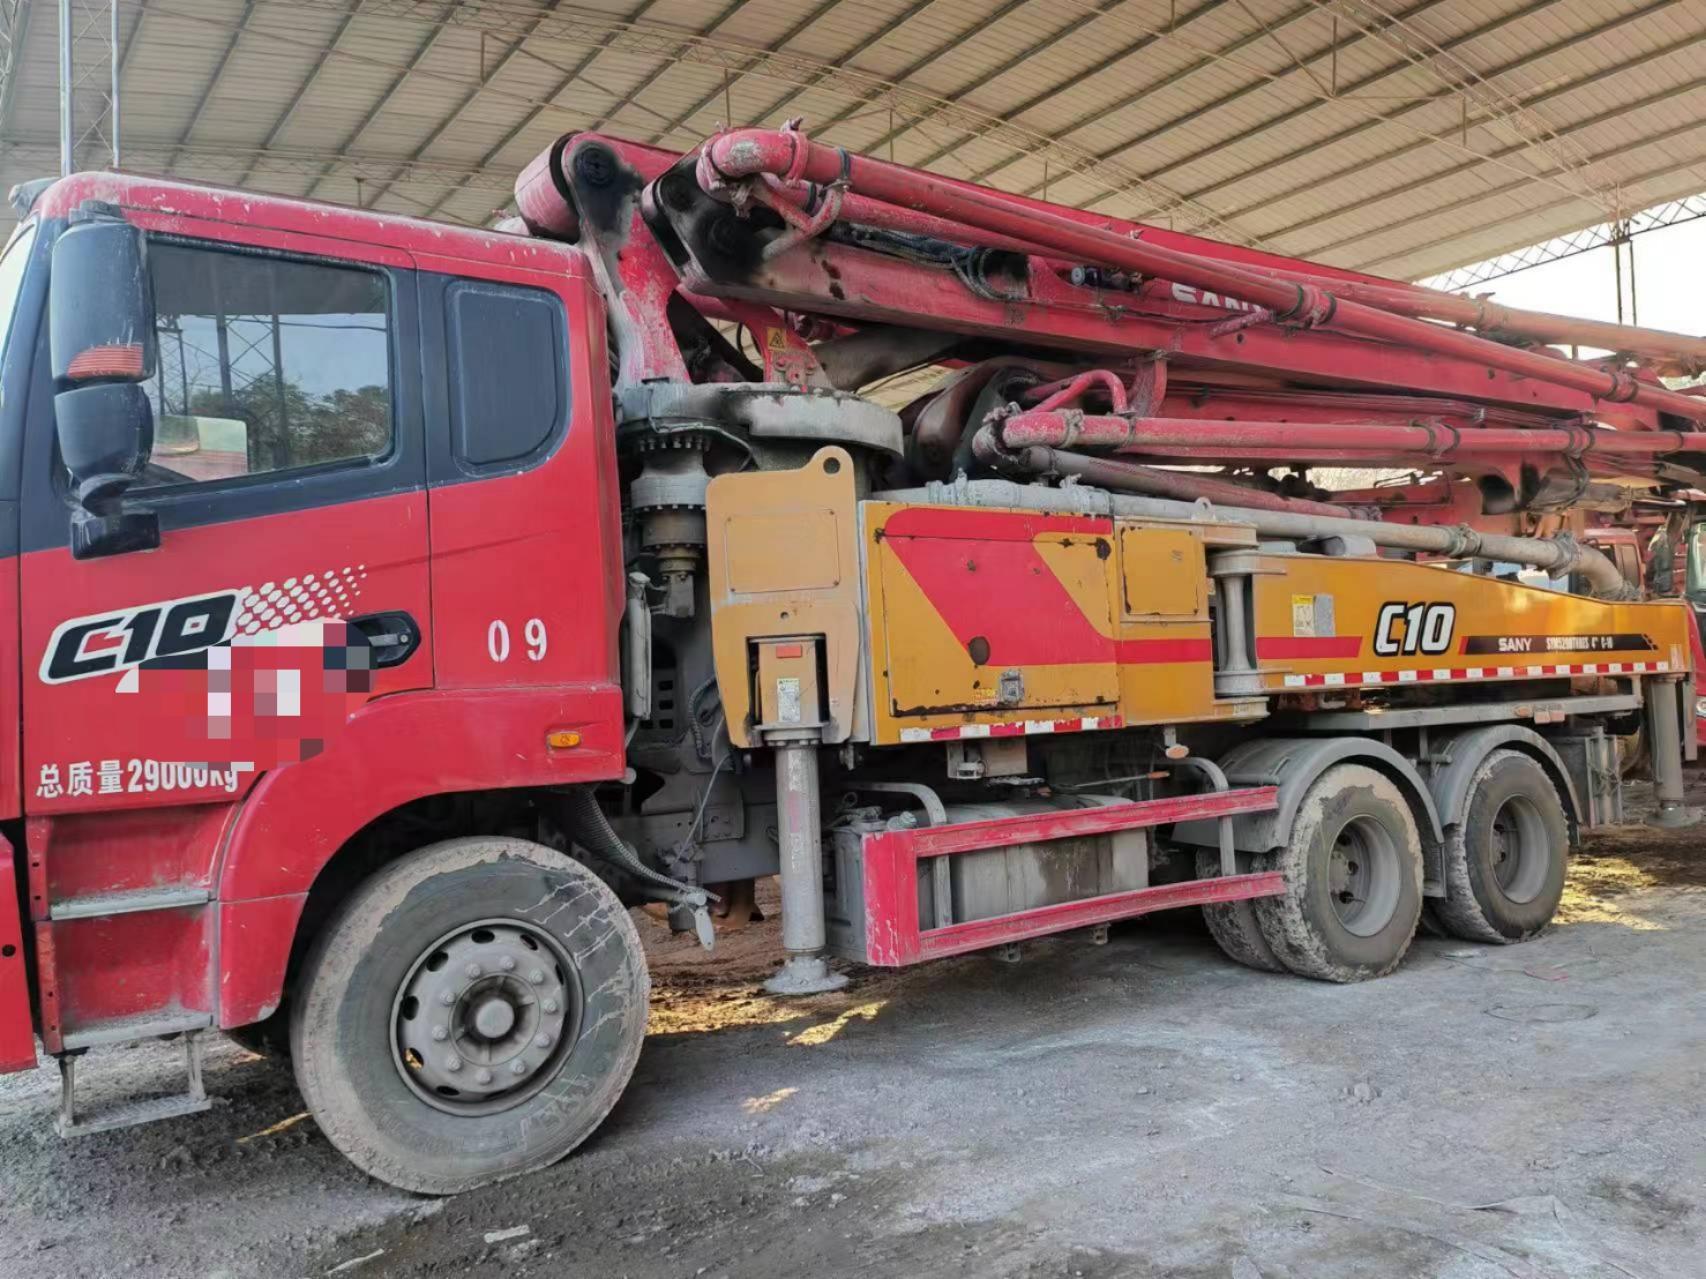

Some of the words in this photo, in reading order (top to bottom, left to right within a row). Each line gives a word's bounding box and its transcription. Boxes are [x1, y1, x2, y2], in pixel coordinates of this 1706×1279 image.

[45, 591, 239, 682] C10
[1374, 601, 1456, 656] C10
[1498, 637, 1532, 651] SANY
